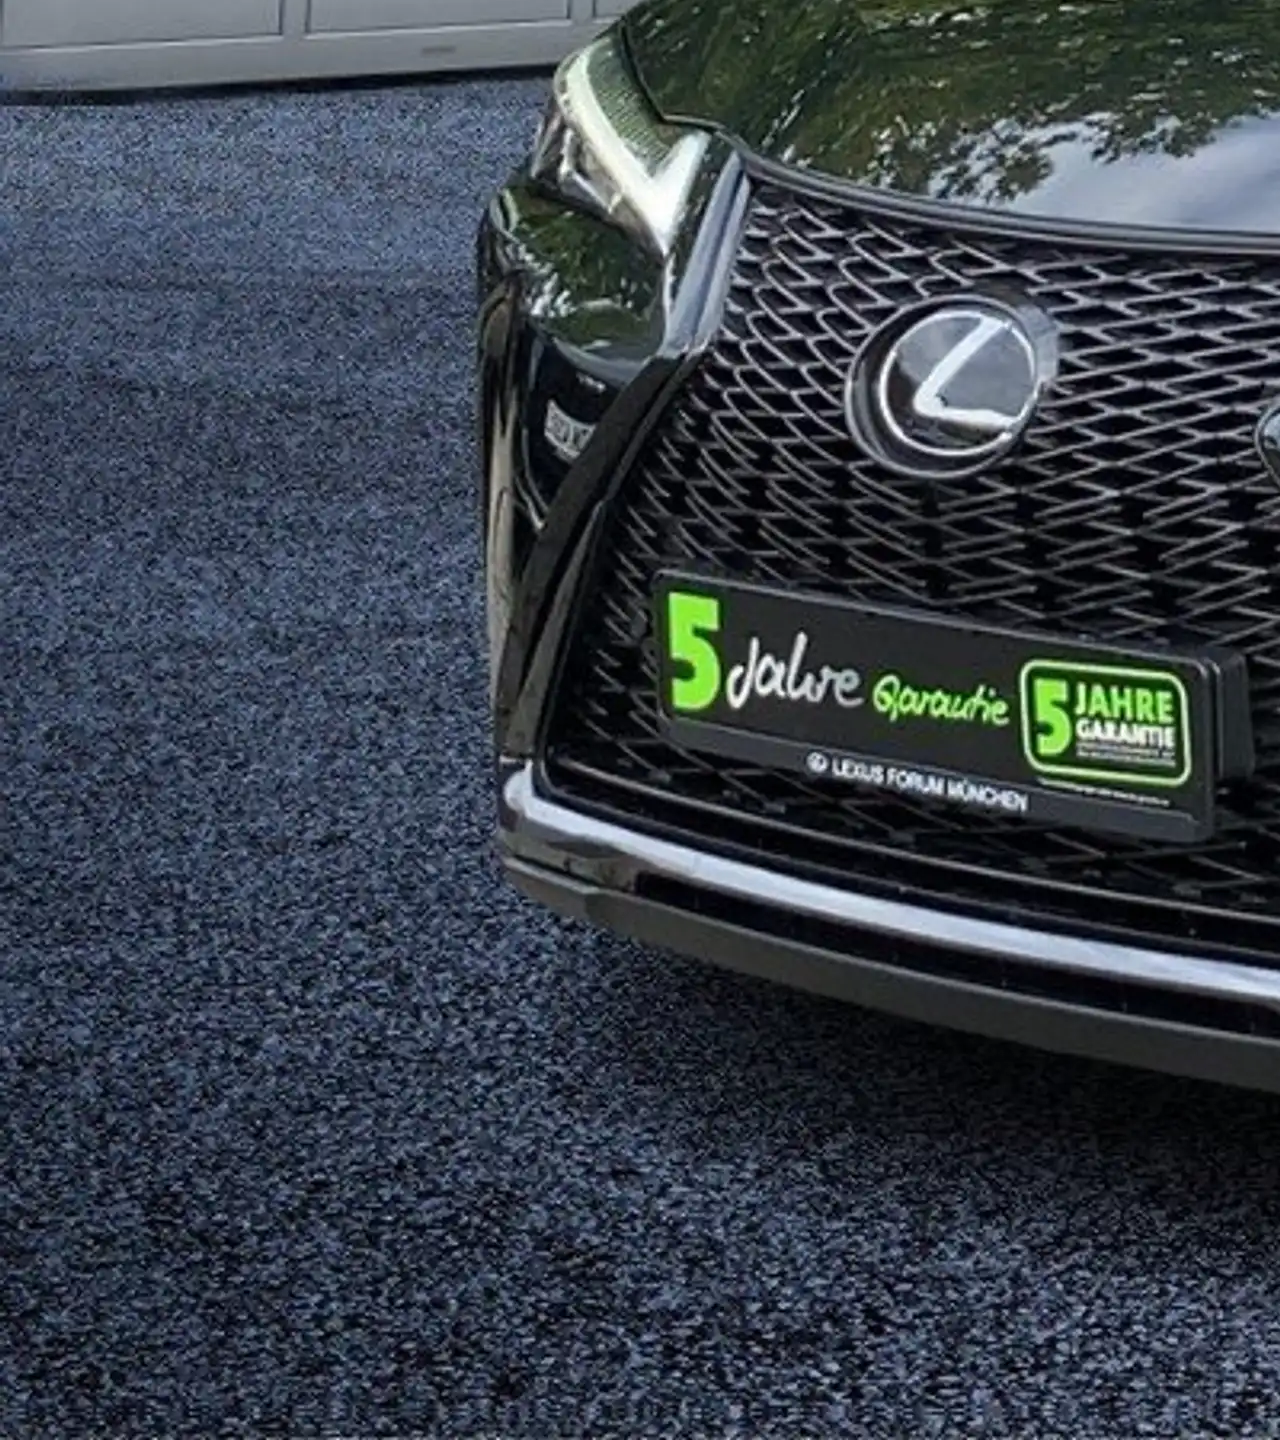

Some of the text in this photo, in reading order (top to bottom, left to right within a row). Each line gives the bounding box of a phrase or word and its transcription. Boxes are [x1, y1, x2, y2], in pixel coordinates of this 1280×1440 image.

[668, 592, 1010, 726] 5 Jahre Garantie
[1034, 678, 1073, 756] 5
[1075, 681, 1174, 724] JAHRE
[1075, 716, 1175, 749] GARANTIE
[831, 758, 885, 785] LEXUS
[887, 767, 945, 796] FORUM
[947, 777, 1029, 813] MÜNCHEN
